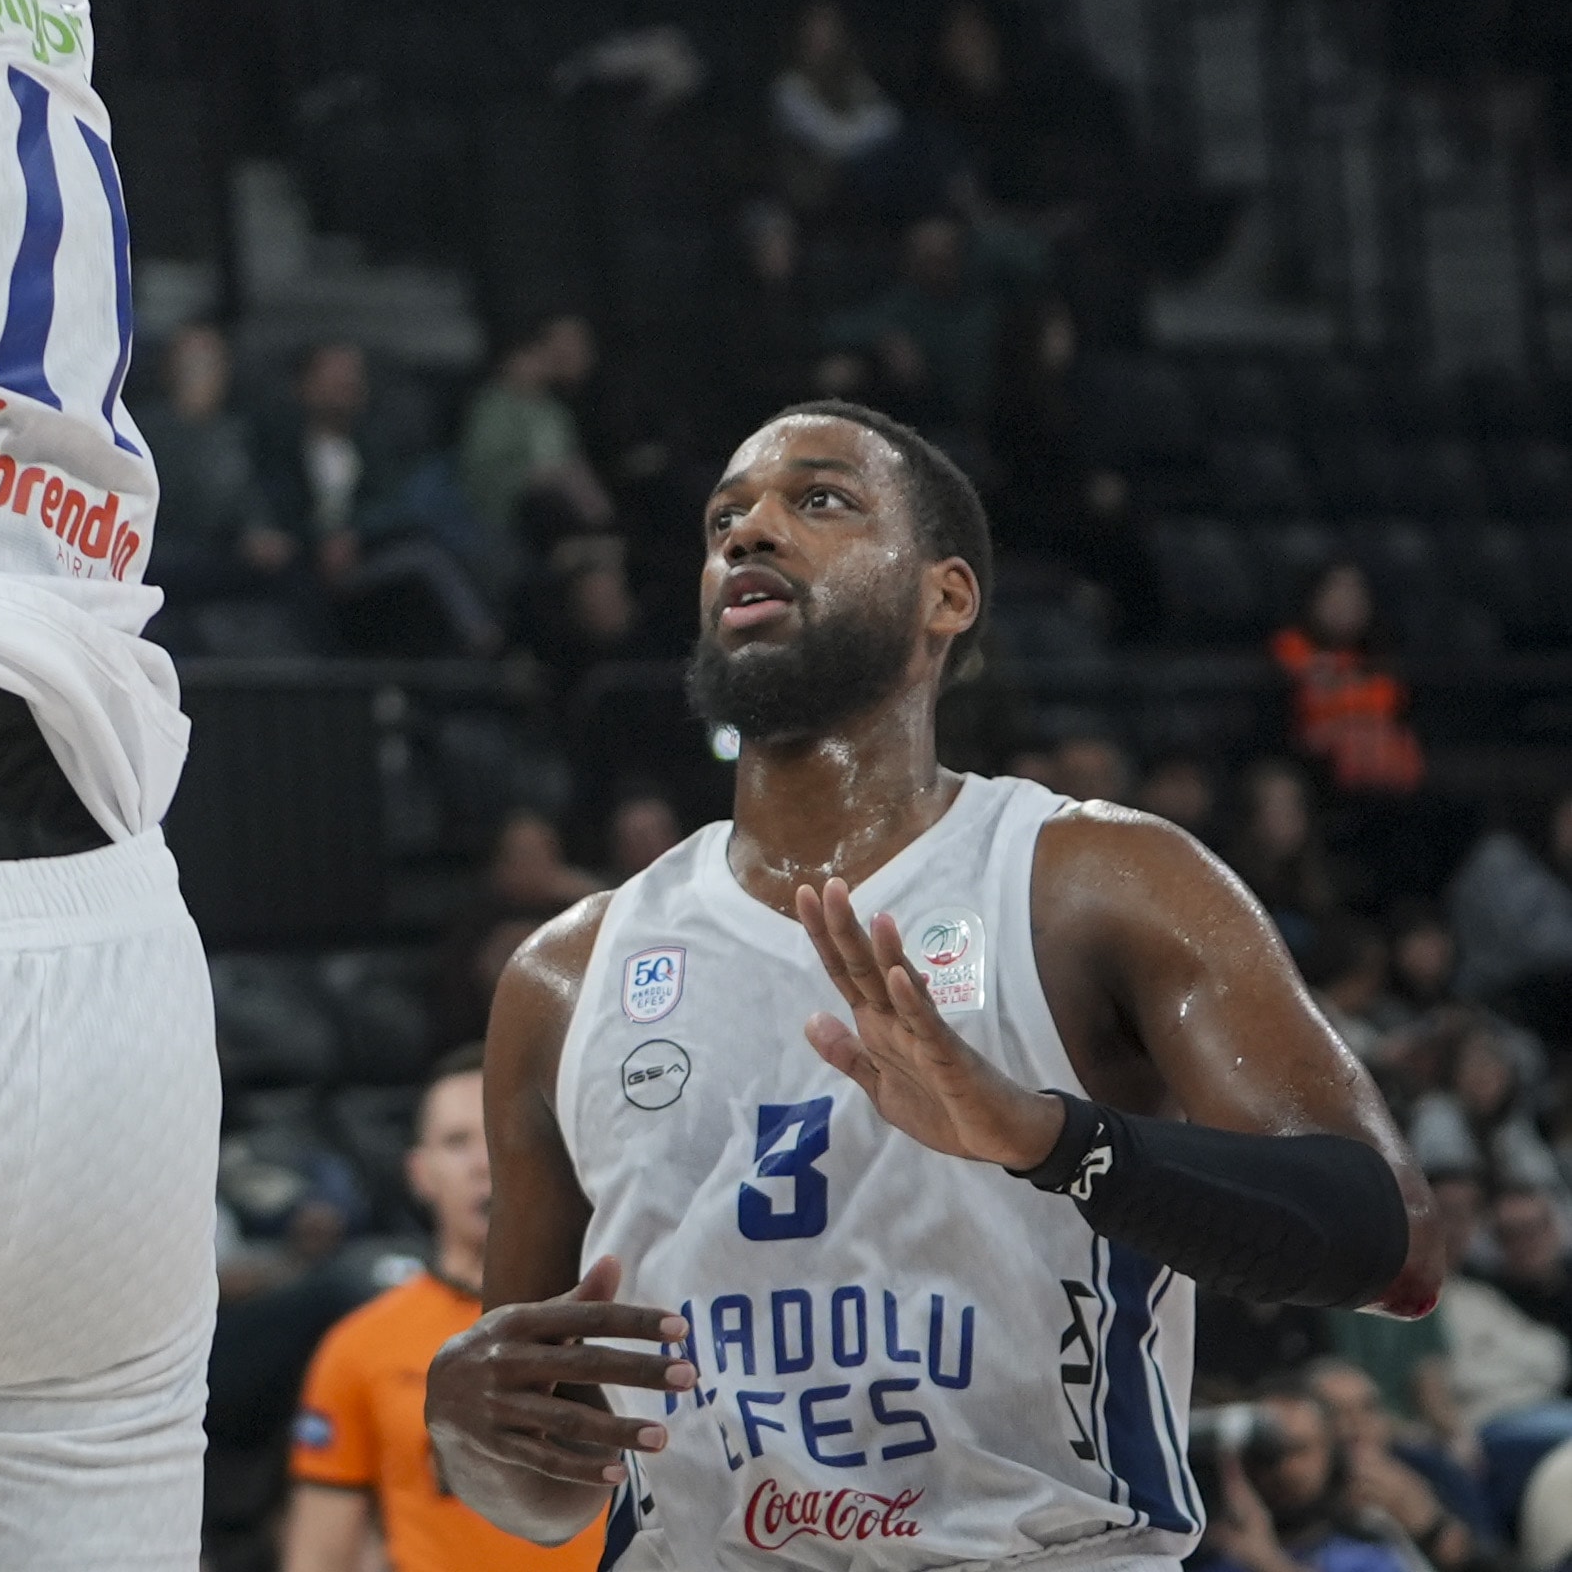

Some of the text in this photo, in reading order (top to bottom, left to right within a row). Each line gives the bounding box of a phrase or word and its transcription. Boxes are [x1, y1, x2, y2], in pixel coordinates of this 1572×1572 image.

[628, 1063, 685, 1086] GSA
[738, 1096, 834, 1242] 3
[659, 1285, 976, 1416] NADOLU
[744, 1478, 926, 1551] Coca-Cola
